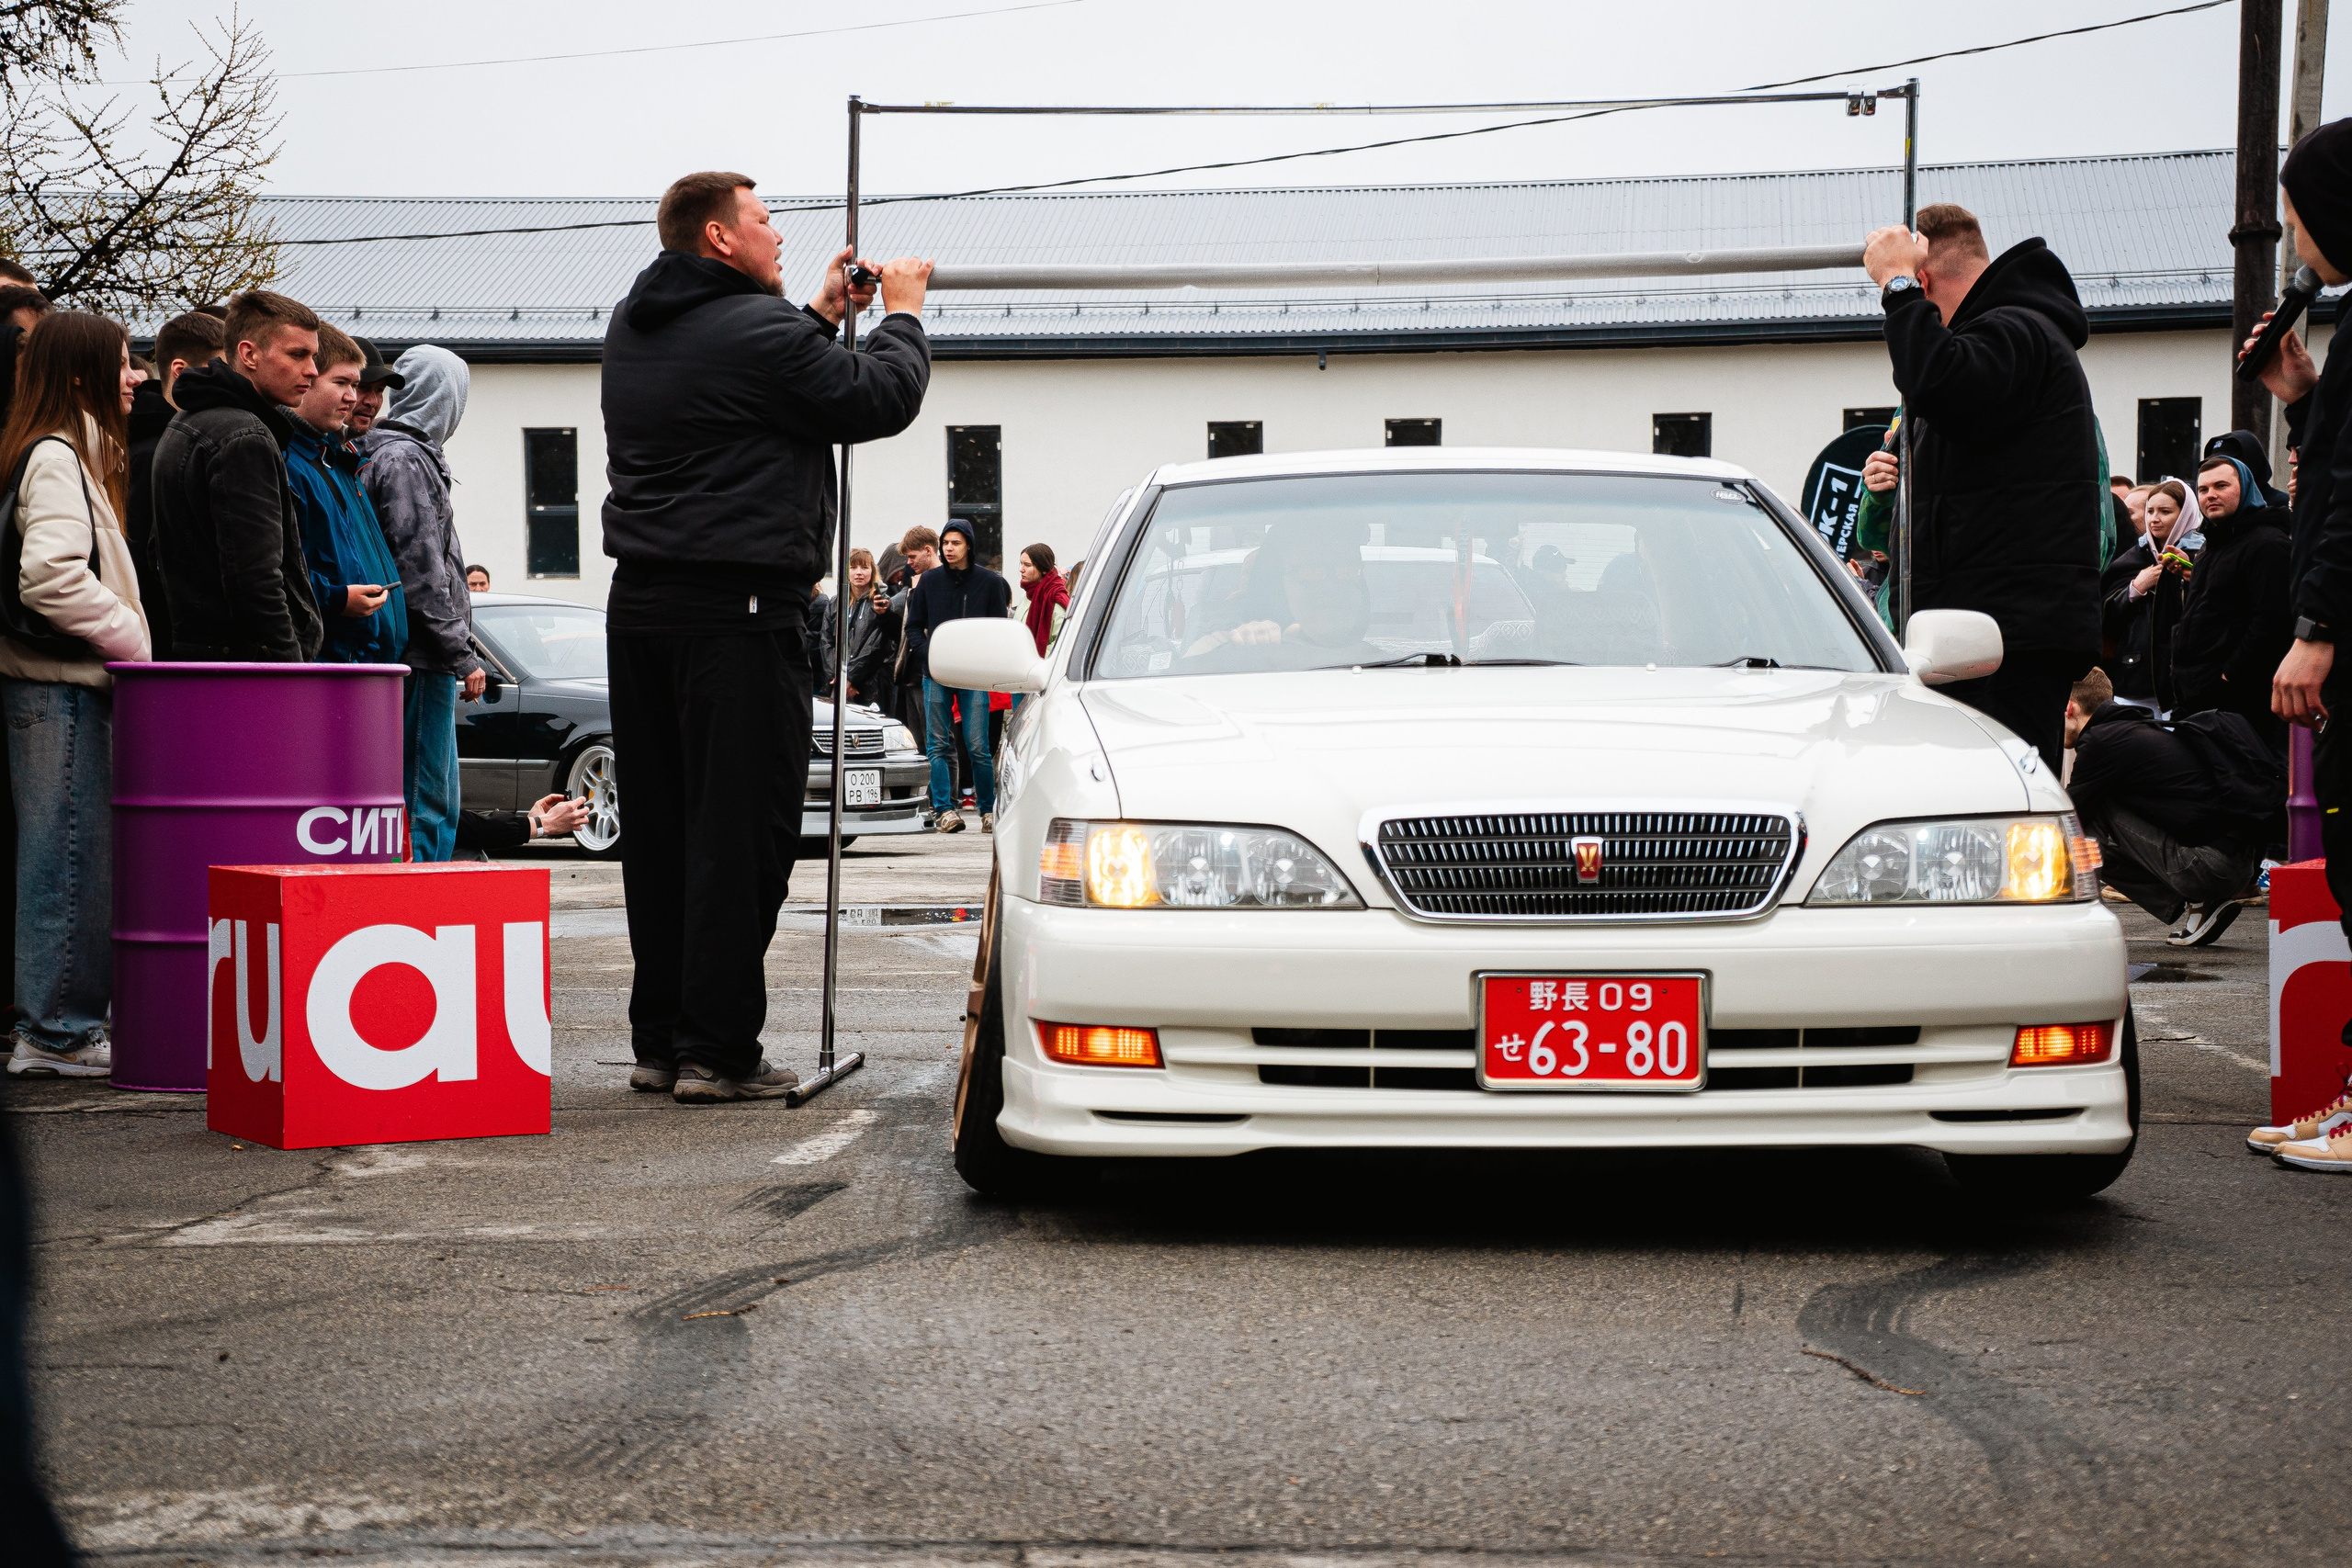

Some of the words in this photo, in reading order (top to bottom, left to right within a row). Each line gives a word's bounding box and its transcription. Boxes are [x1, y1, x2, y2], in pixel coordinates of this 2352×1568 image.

[860, 773, 875, 785] 200
[849, 790, 862, 802] РВ
[866, 788, 878, 798] 196
[1529, 981, 1590, 1011] 野長
[1599, 983, 1653, 1012] 09
[1494, 1032, 1526, 1062] せ
[1528, 1020, 1689, 1077] 63-80
